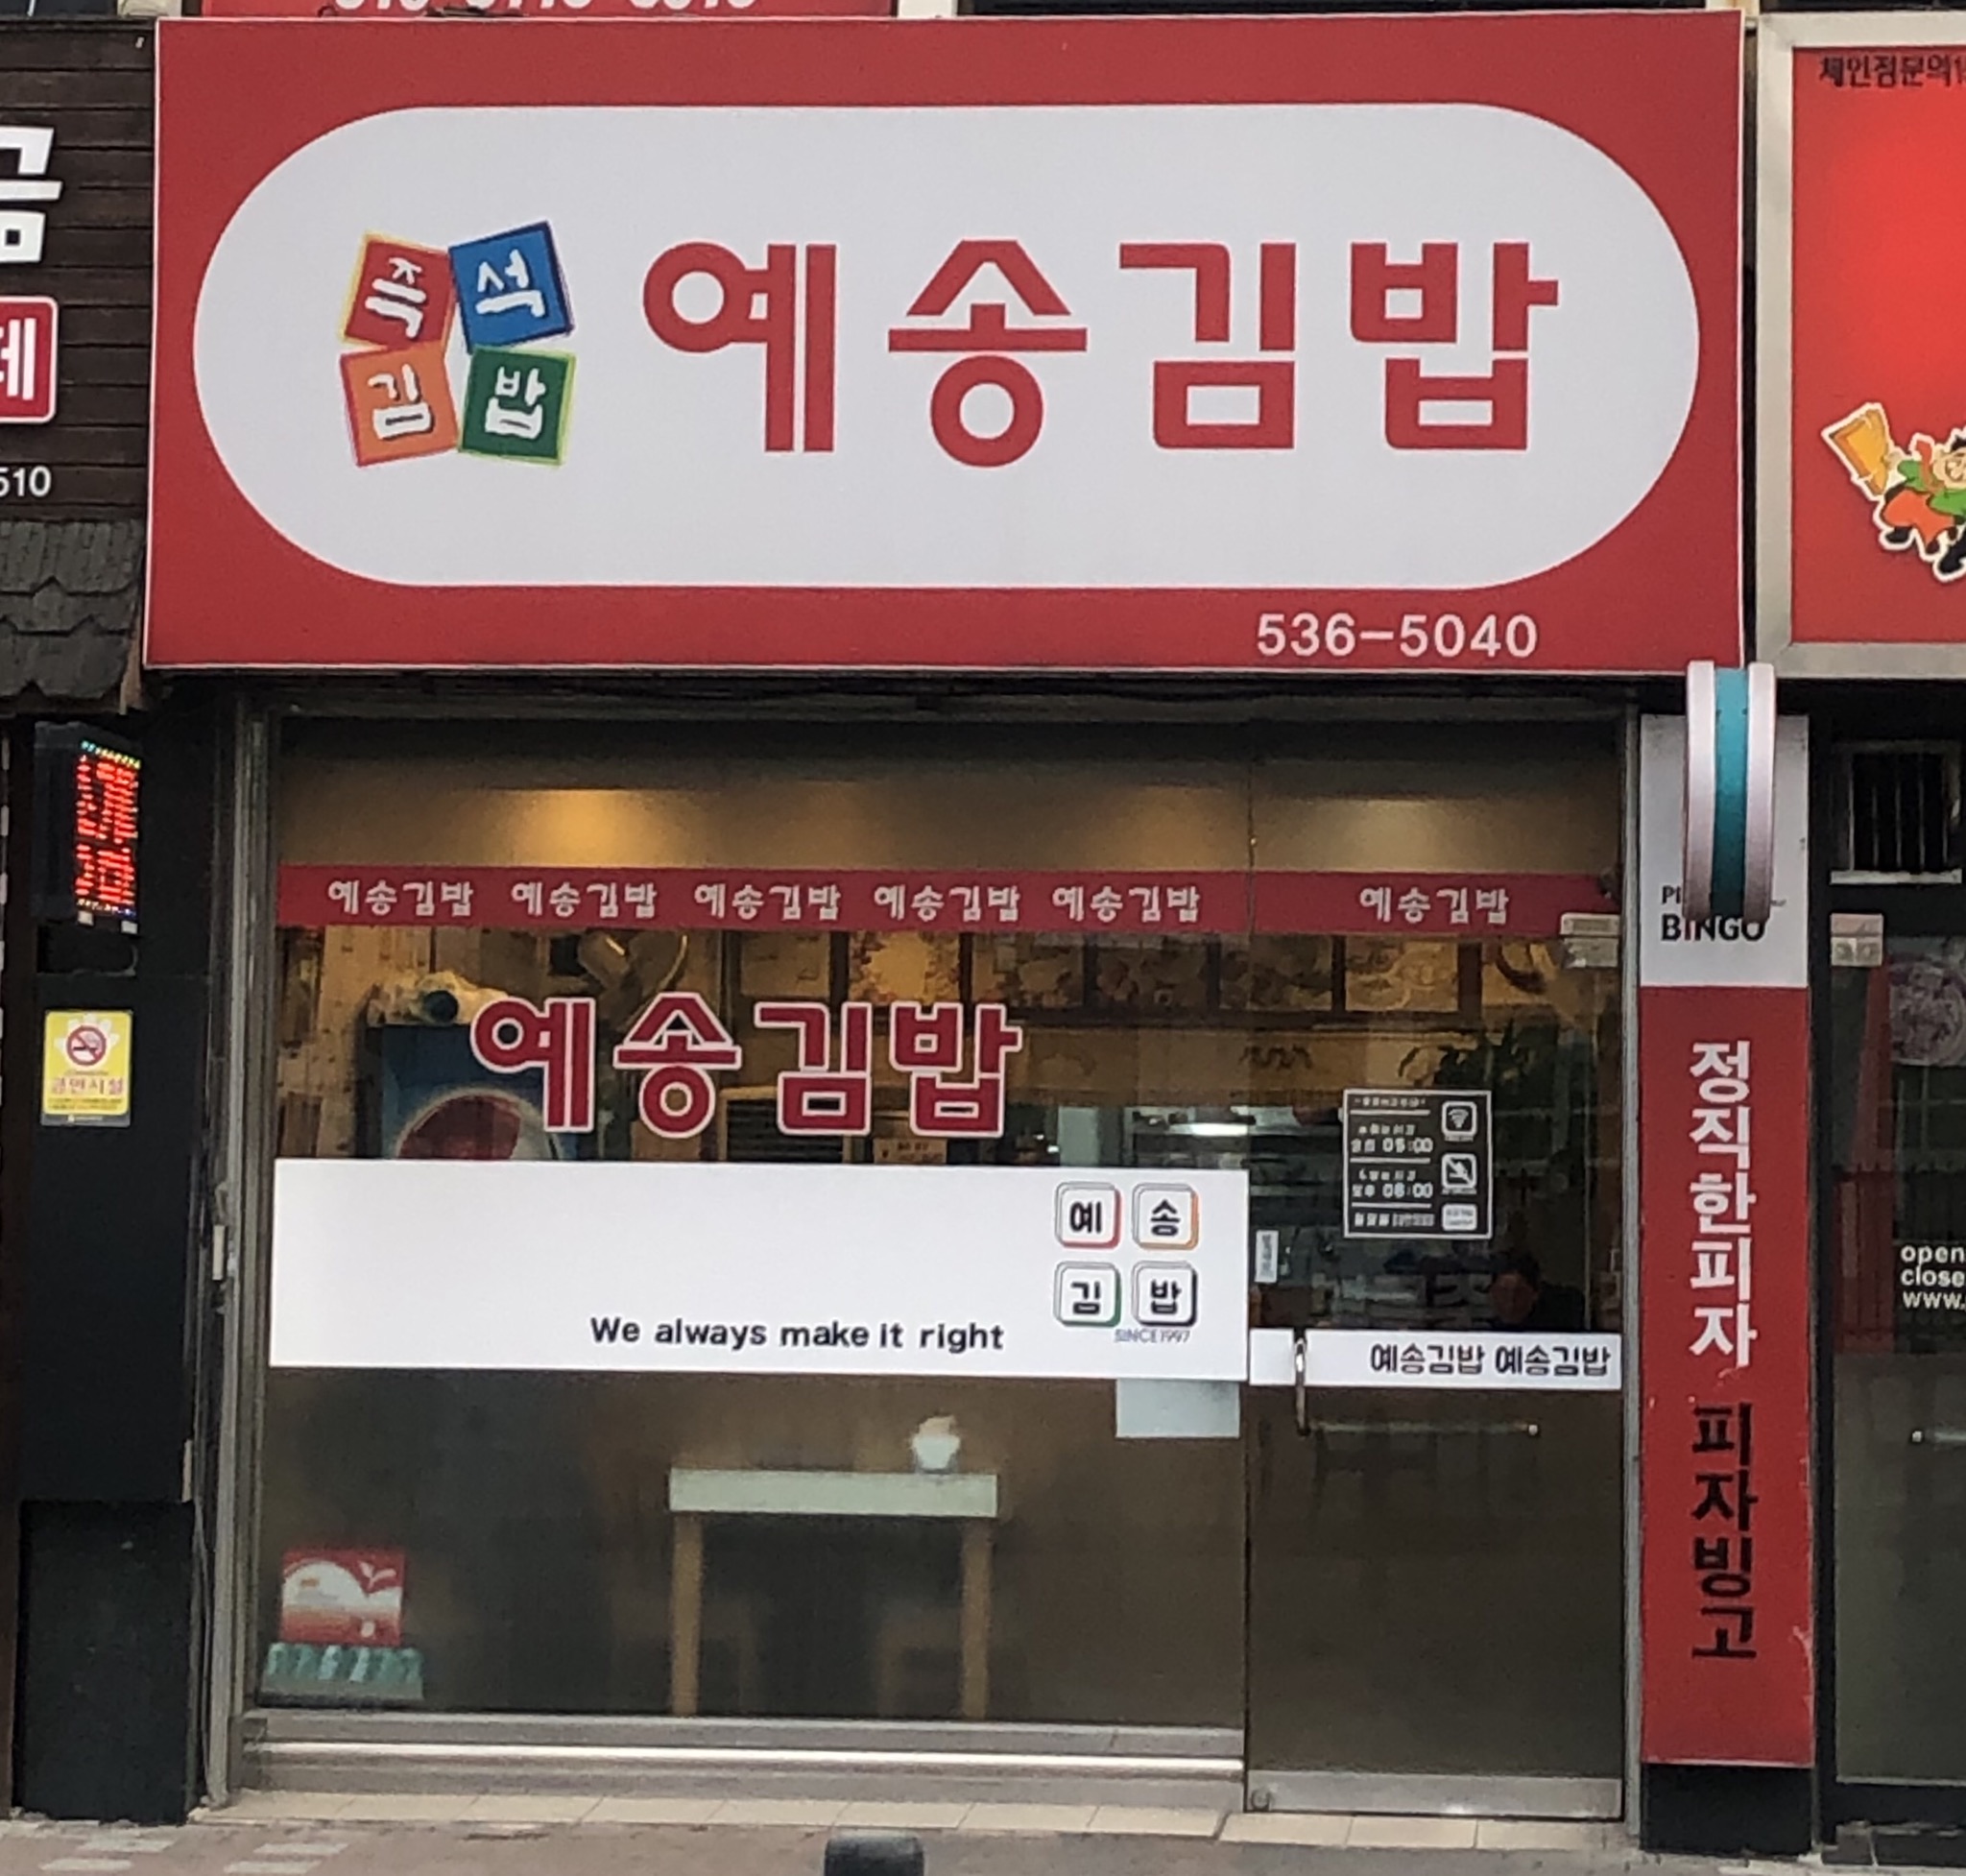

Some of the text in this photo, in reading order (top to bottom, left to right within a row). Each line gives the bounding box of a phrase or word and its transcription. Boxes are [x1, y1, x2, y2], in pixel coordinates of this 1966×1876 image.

[643, 238, 1559, 468] 예송김밥
[1257, 613, 1537, 659] 536-5040
[328, 879, 1509, 925] 예송김밥 예송김밥 예송김밥 예송김밥 예송김밥 예송김밥
[1661, 914, 1766, 942] BINGO
[470, 992, 1022, 1138] 예송김밥
[1903, 1291, 1966, 1310] www.
[590, 1316, 641, 1343] We
[654, 1317, 767, 1351] always
[779, 1320, 870, 1349] make
[919, 1322, 1005, 1355] right
[1370, 1342, 1611, 1377] 예송김밥 예송김밥
[1690, 1401, 1759, 1660] 피자빙고
